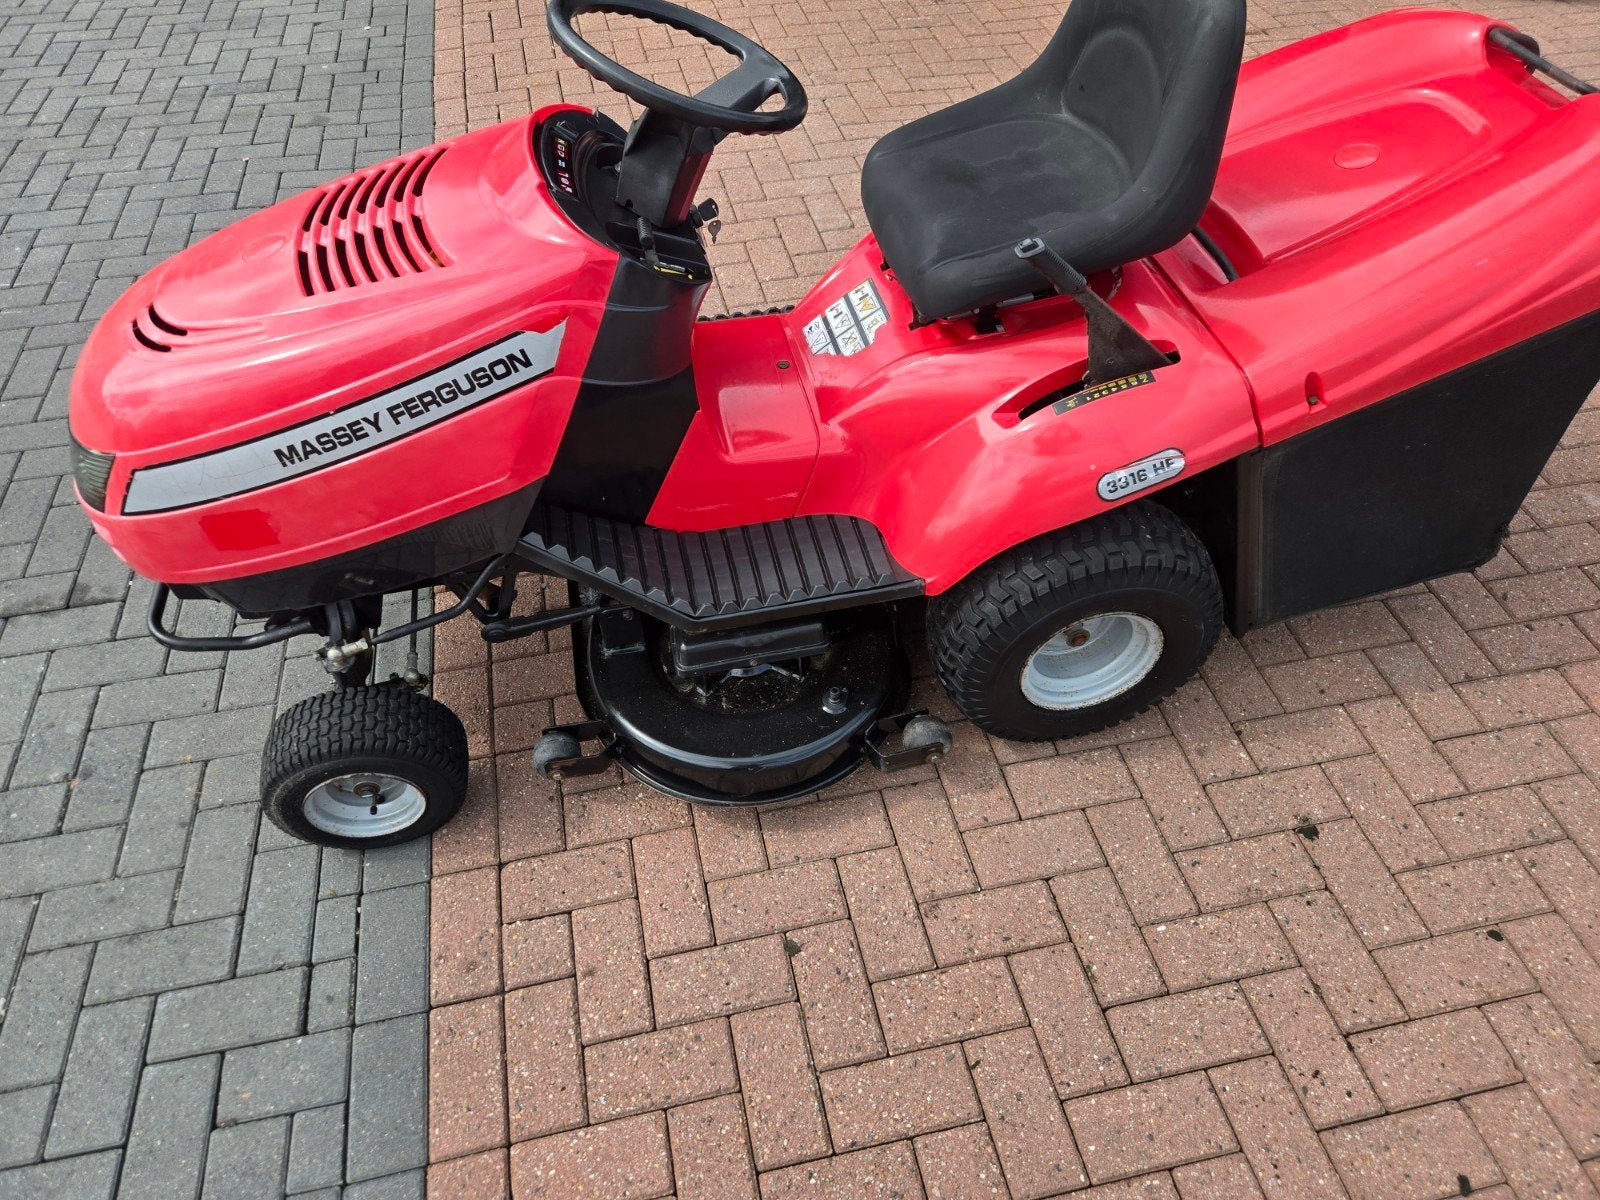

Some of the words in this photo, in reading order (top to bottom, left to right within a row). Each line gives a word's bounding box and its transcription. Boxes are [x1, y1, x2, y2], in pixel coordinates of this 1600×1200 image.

[274, 412, 383, 468] MASSEY
[386, 348, 534, 425] FERGUSON
[1106, 469, 1148, 494] 3316
